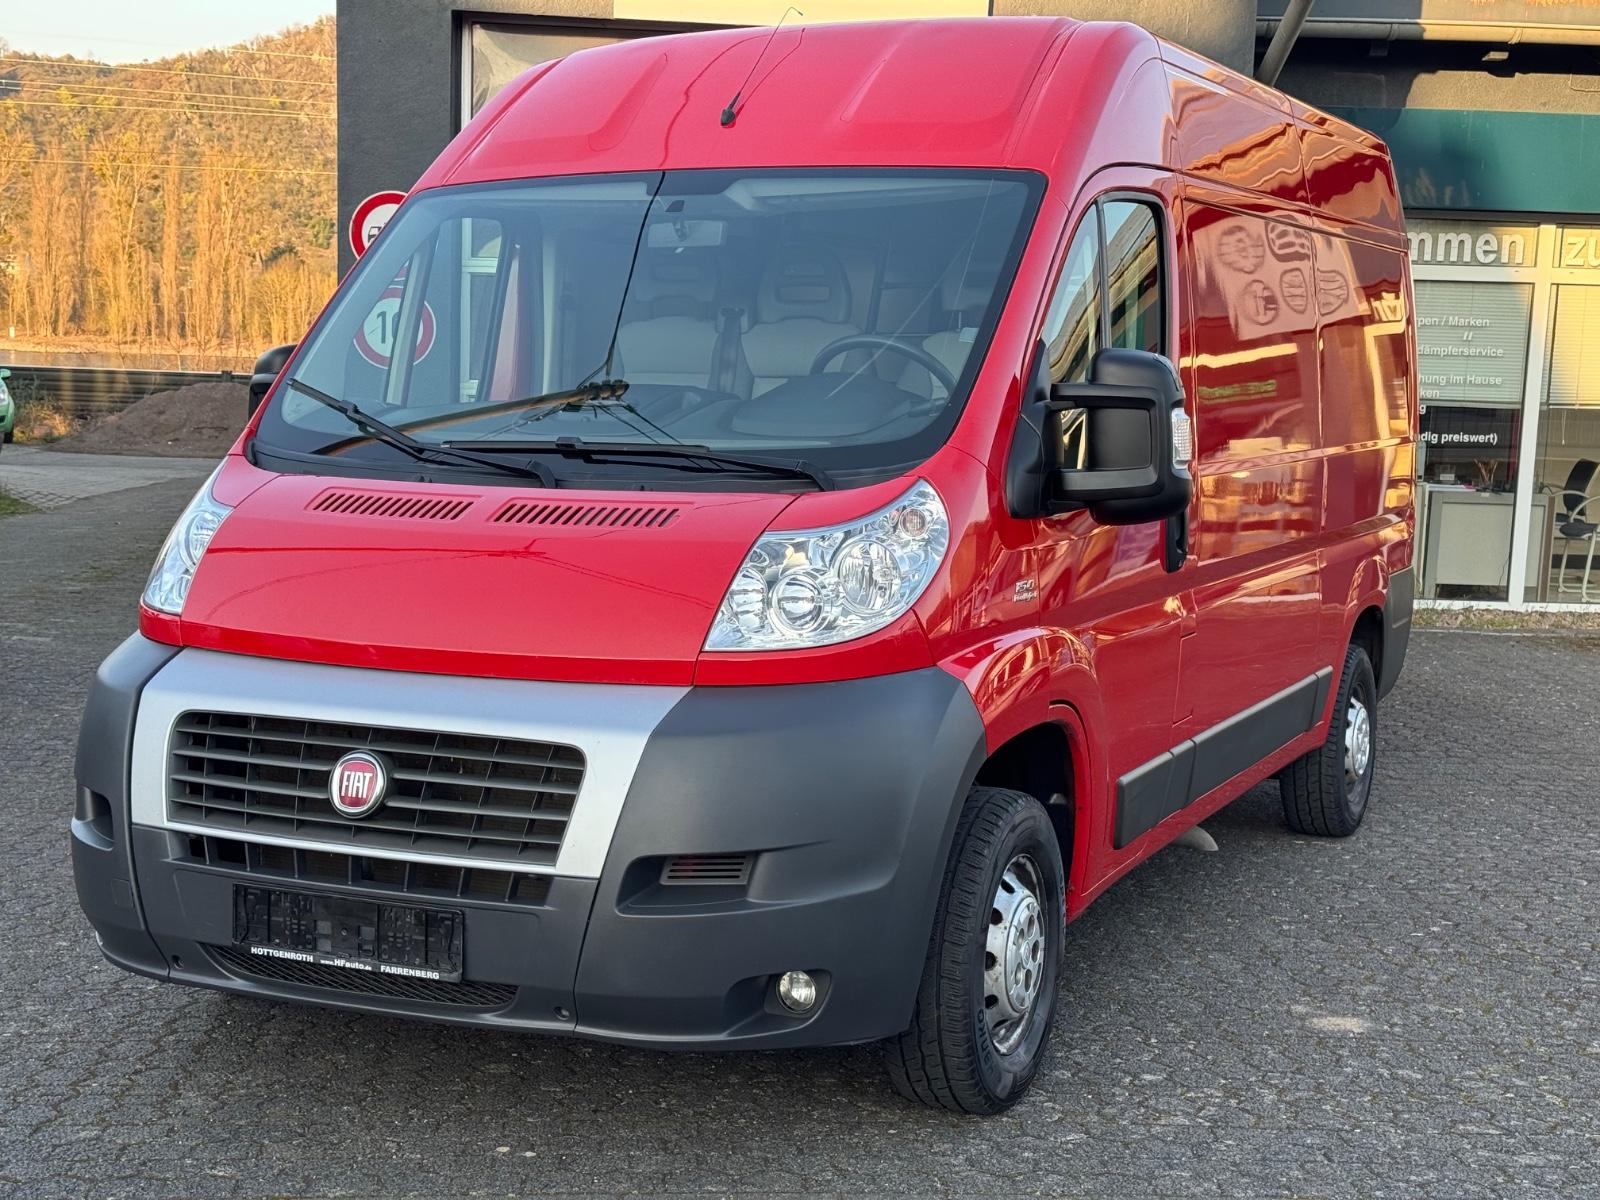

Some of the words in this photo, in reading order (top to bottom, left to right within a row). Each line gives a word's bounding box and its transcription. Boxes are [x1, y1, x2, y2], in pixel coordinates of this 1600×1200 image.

[1448, 316, 1491, 327] Marken
[1449, 374, 1464, 385] im
[1466, 375, 1503, 386] Hause
[1441, 432, 1499, 446] preiswert)
[341, 770, 374, 799] FIAT
[250, 946, 314, 963] HOTTGENROTH
[320, 958, 373, 972] www.HFauto.de
[380, 965, 440, 980] FARRENBERG
